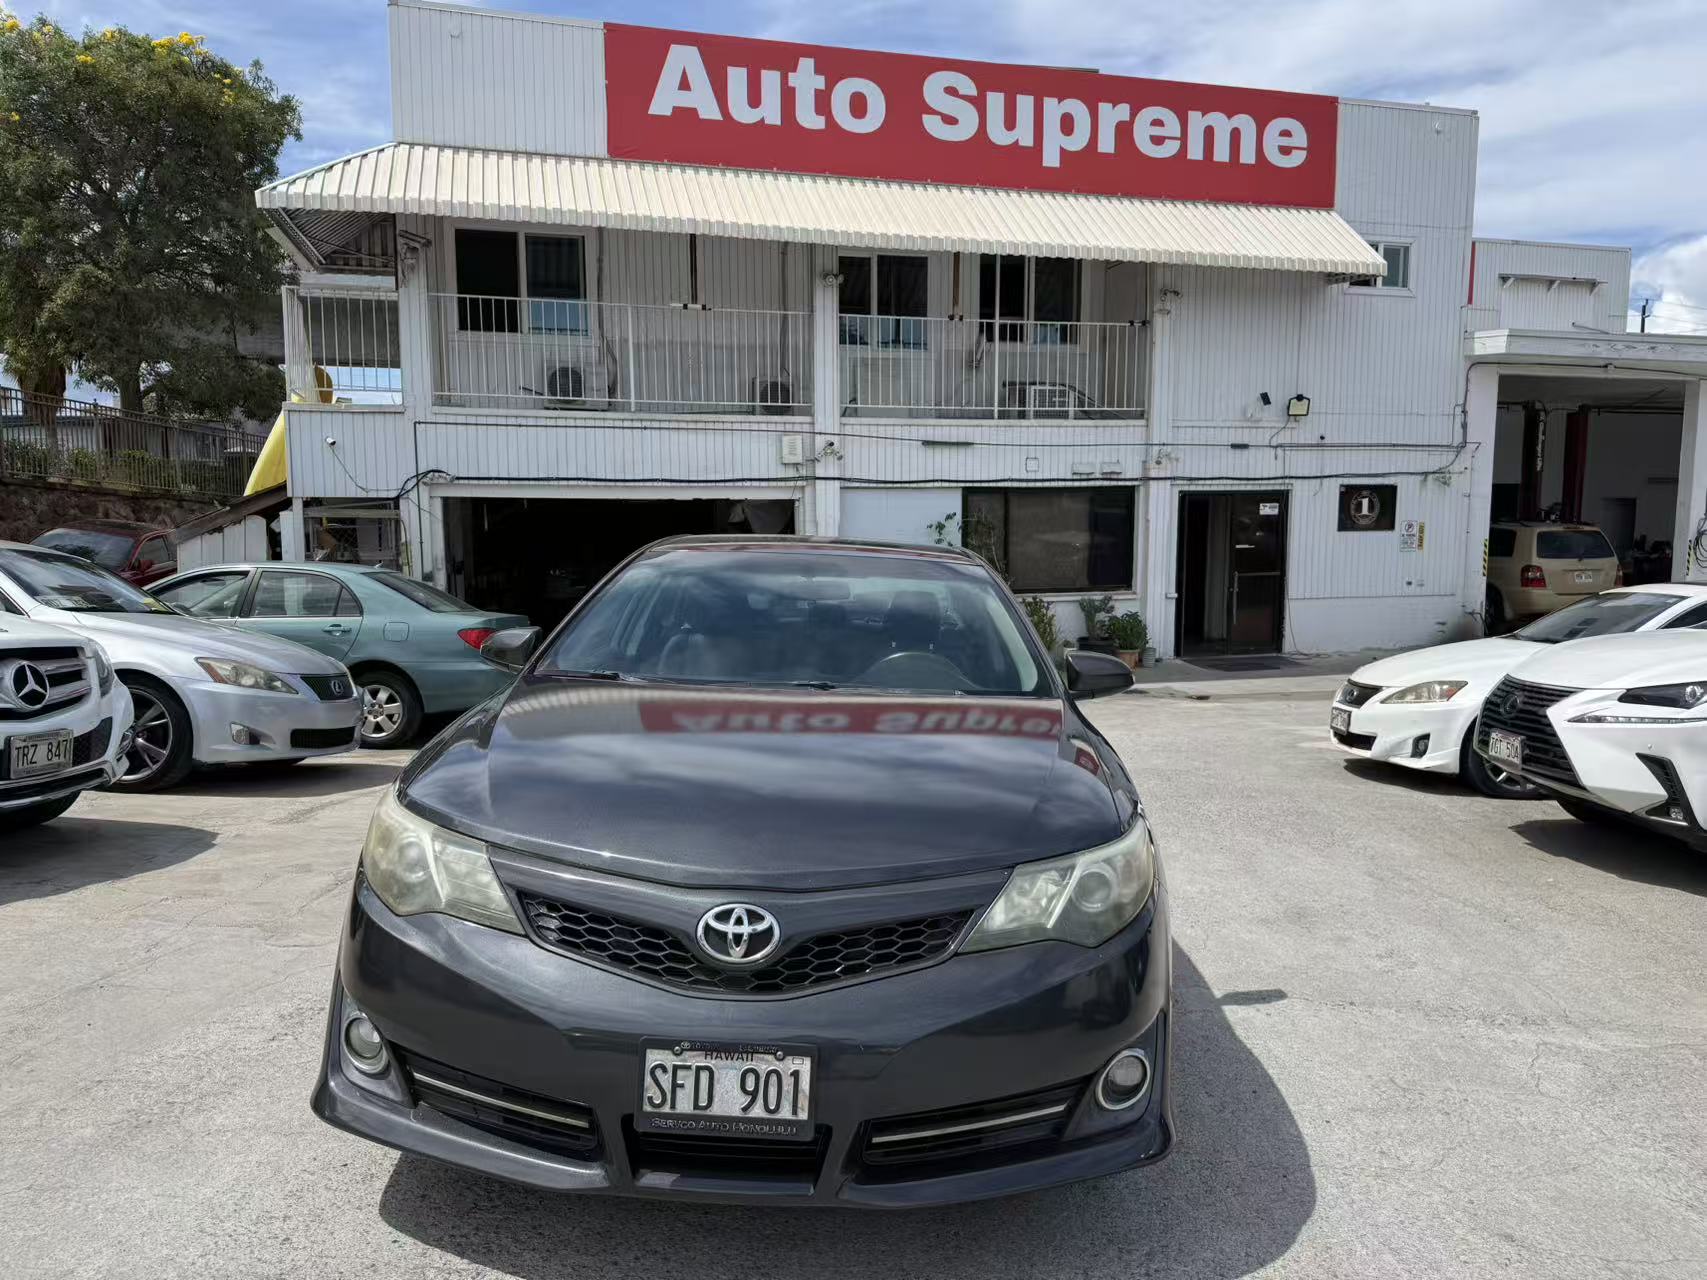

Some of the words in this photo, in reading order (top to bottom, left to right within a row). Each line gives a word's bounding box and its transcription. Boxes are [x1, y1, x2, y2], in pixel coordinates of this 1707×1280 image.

[648, 43, 886, 133] Auto
[921, 70, 1308, 168] Supreme
[15, 744, 38, 768] TRZ
[46, 740, 68, 761] 847
[647, 1061, 715, 1111] SFD
[740, 1066, 800, 1116] 901
